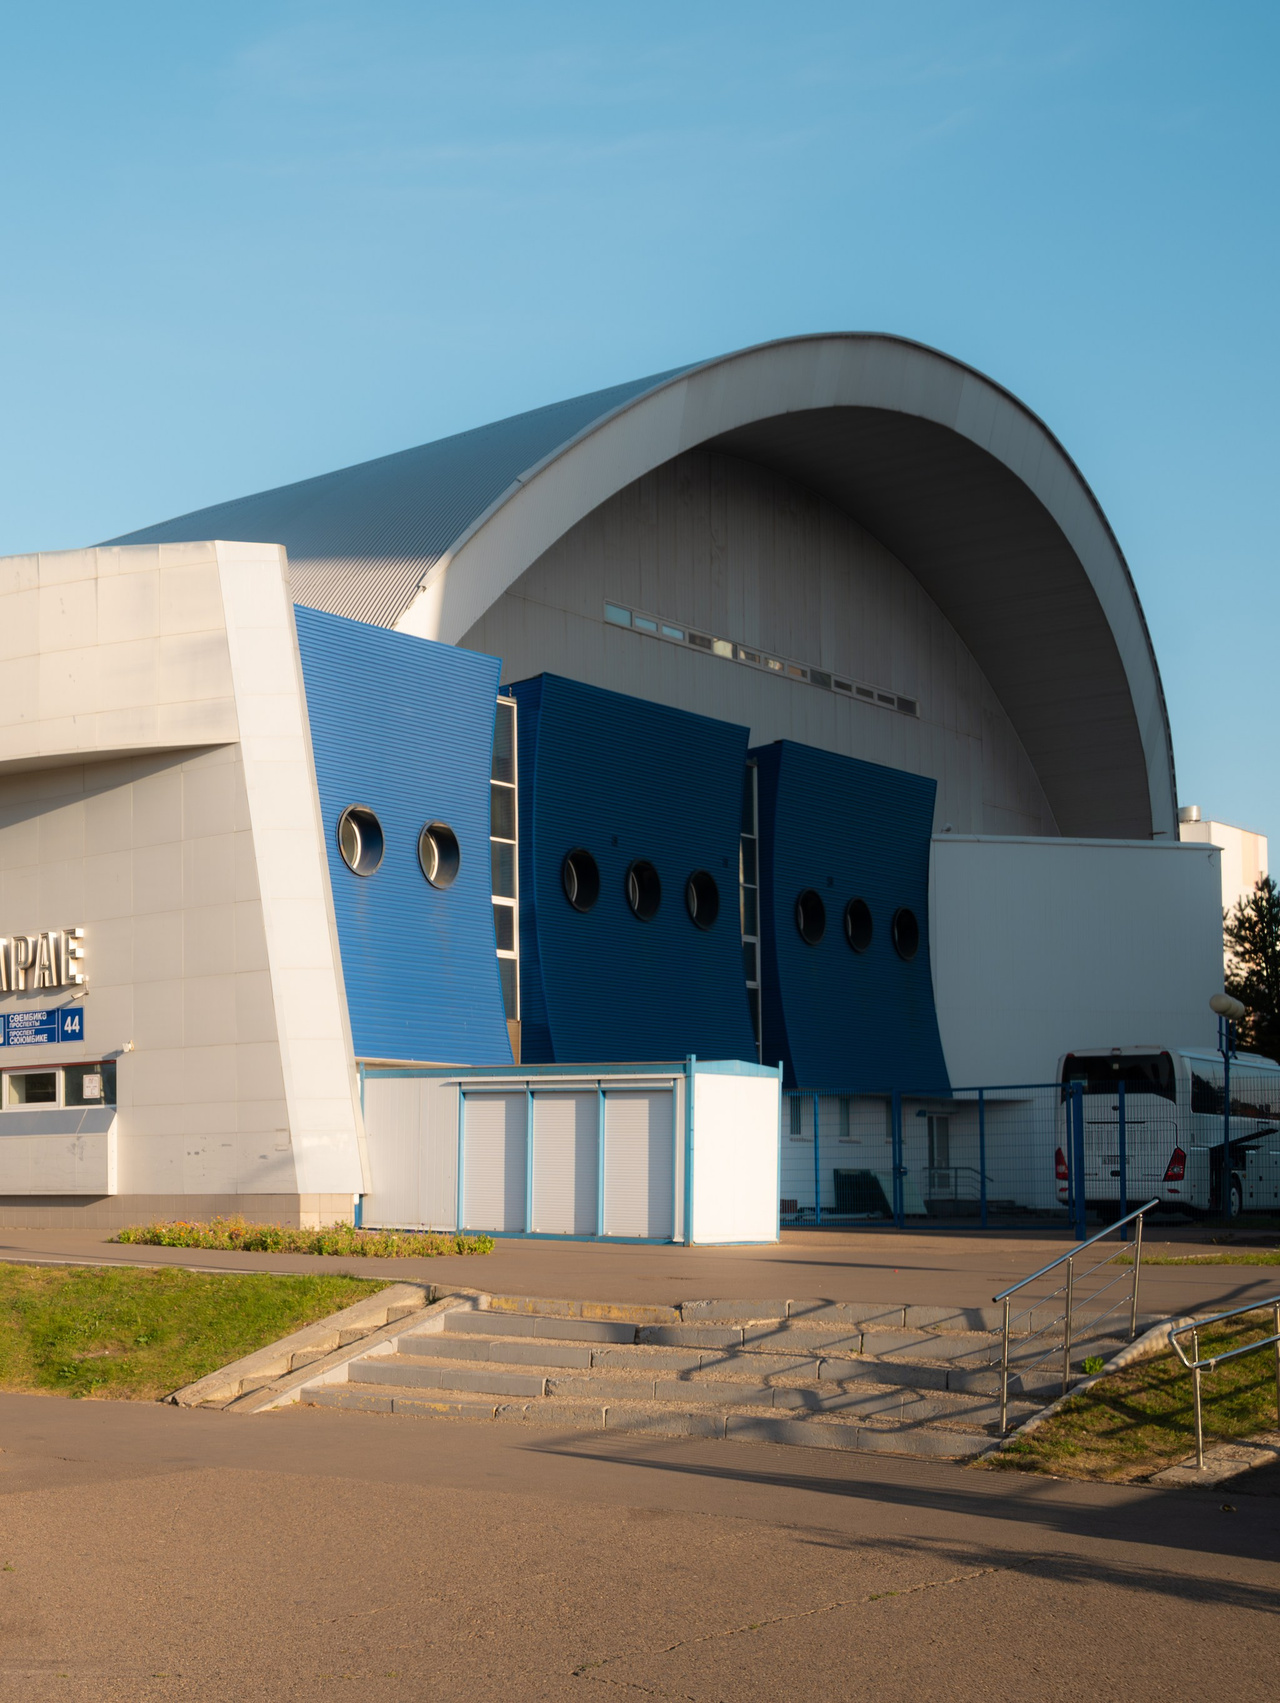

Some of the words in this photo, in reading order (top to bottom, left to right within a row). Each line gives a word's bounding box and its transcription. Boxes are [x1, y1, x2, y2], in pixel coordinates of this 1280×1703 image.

[9, 1020, 40, 1028] ПРОСПЕКТЫ
[64, 1015, 80, 1034] 44
[9, 1029, 35, 1037] ПРОСПЕКТ
[9, 1034, 48, 1045] СЮЮМБИКЕ
